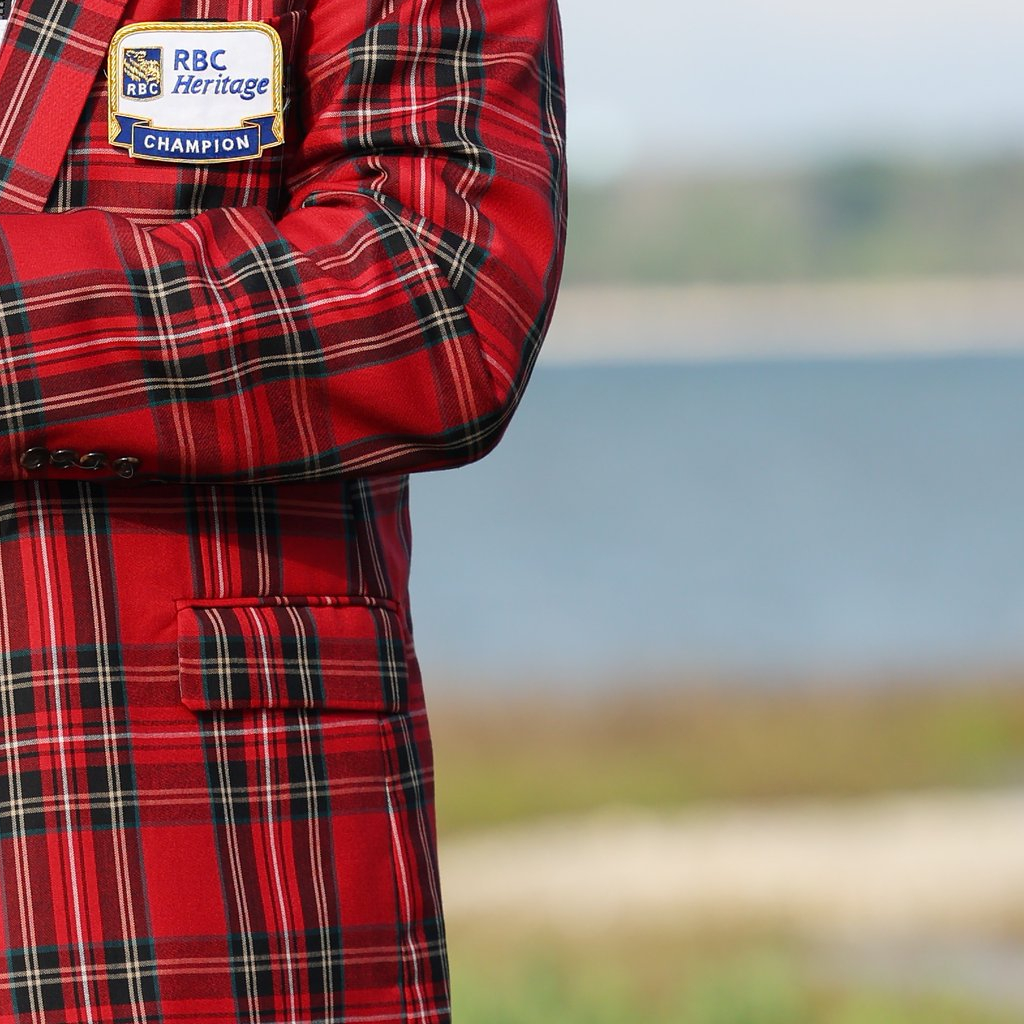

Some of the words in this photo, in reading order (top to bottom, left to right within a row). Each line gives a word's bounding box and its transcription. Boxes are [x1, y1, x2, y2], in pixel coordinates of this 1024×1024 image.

[173, 49, 227, 71] RBC
[126, 82, 159, 96] RBC
[171, 73, 269, 101] Heritage
[143, 134, 250, 154] CHAMPION
